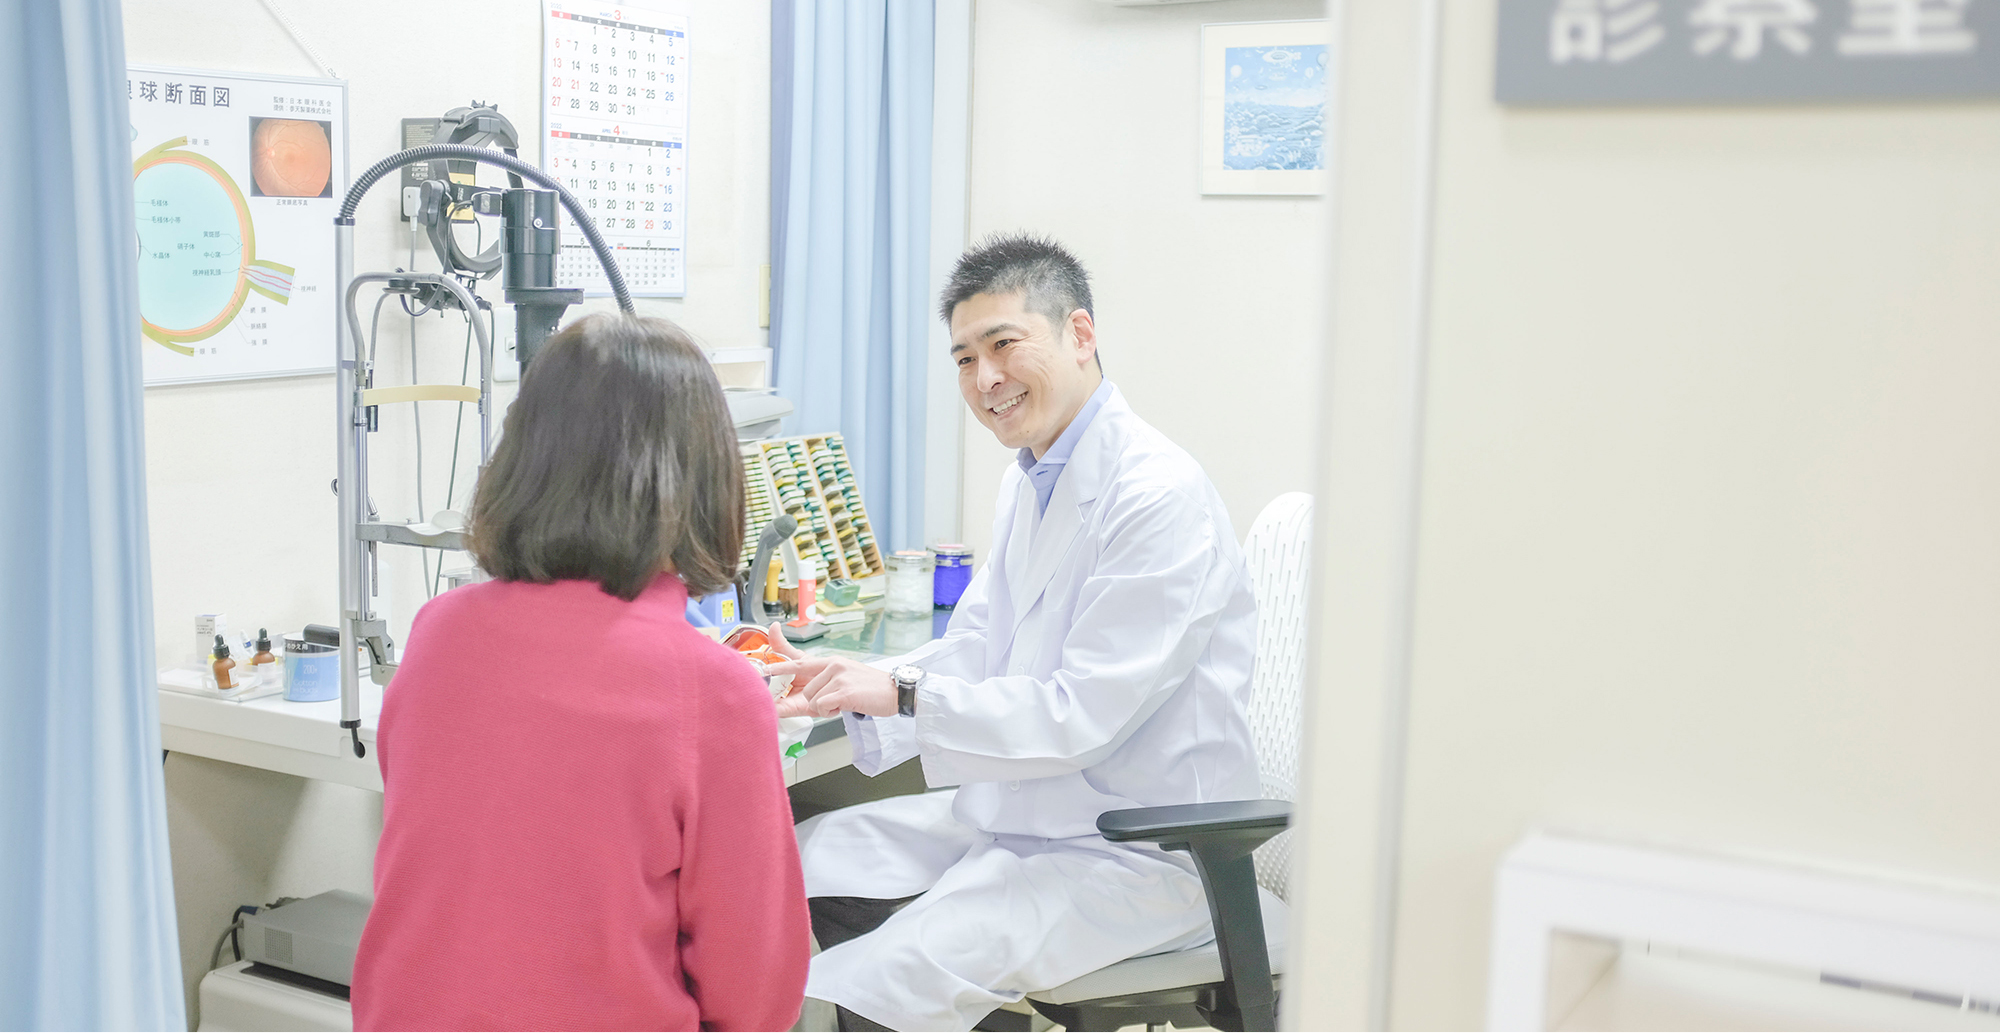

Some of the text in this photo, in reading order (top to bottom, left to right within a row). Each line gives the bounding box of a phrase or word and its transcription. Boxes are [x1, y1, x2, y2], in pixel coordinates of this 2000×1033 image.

[615, 10, 621, 20] 3
[594, 26, 673, 46] 1 2 3 4 5
[556, 38, 675, 65] 6 7 8 9 10 11 12
[554, 58, 674, 83] 13 14 15 16 17 18 19
[552, 77, 674, 101] 20 21 22 23 24 25 26
[552, 96, 635, 115] 27 28 29 30 31
[614, 126, 620, 135] 4
[648, 148, 651, 156] 1
[666, 149, 670, 158] 2
[554, 158, 670, 176] 3 4 5 6 7 8 9
[570, 178, 578, 188] 11
[589, 180, 597, 189] 12
[608, 181, 616, 190] 13
[627, 183, 635, 191] 14
[646, 184, 654, 193] 15
[664, 185, 672, 194] 16
[588, 199, 672, 212] 19 20 21 22 23
[606, 218, 616, 228] 27
[626, 219, 635, 228] 28
[645, 220, 654, 229] 29
[663, 220, 671, 230] 30
[580, 238, 584, 246] 5
